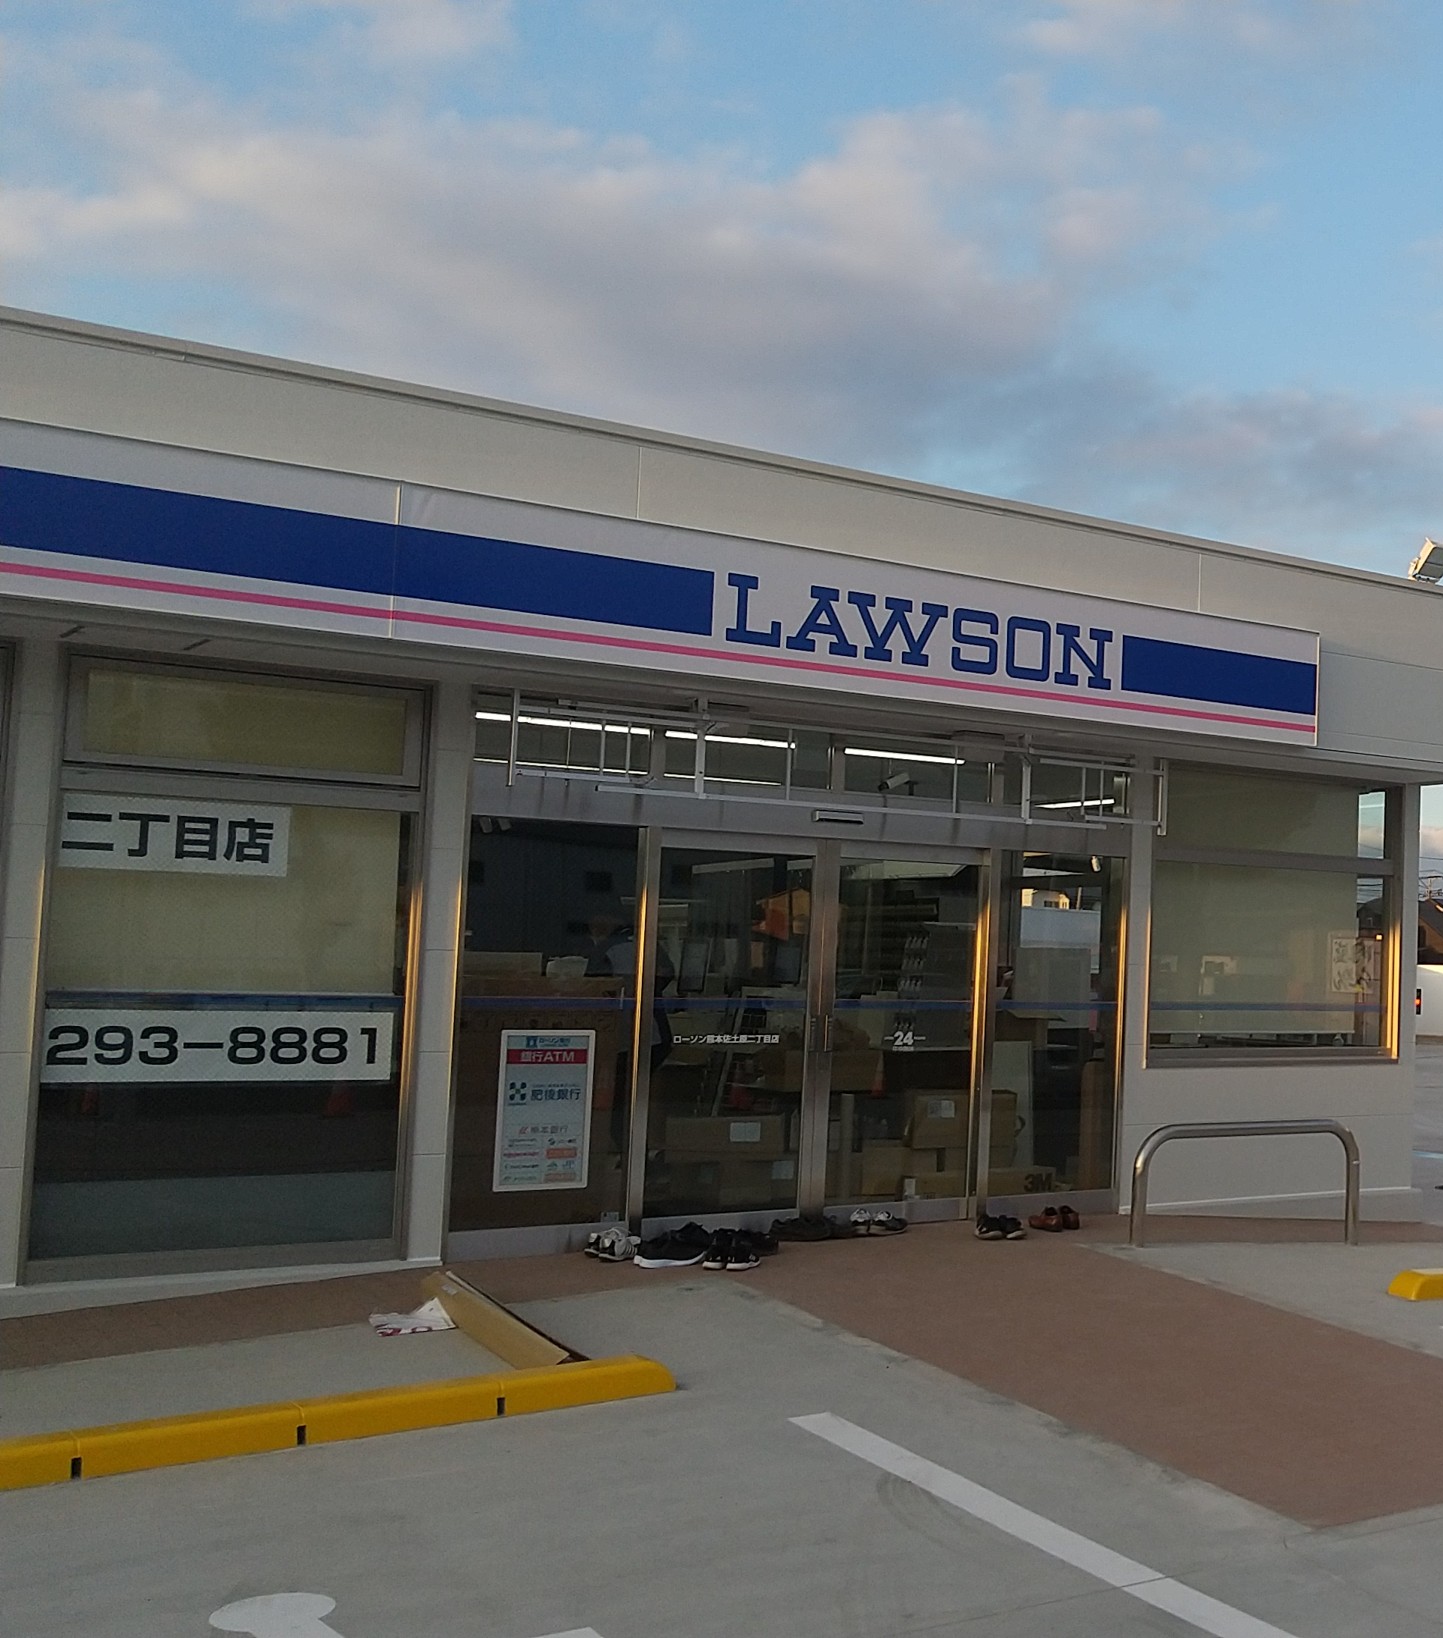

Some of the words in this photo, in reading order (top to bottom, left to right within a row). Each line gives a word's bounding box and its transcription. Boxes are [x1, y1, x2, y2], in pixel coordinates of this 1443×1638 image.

[725, 572, 1113, 691] LAWSON
[61, 810, 275, 865] 二丁目店
[520, 1051, 575, 1062] 銀行ATM
[530, 1088, 581, 1101] 肥後銀行
[1023, 1172, 1053, 1192] 3M
